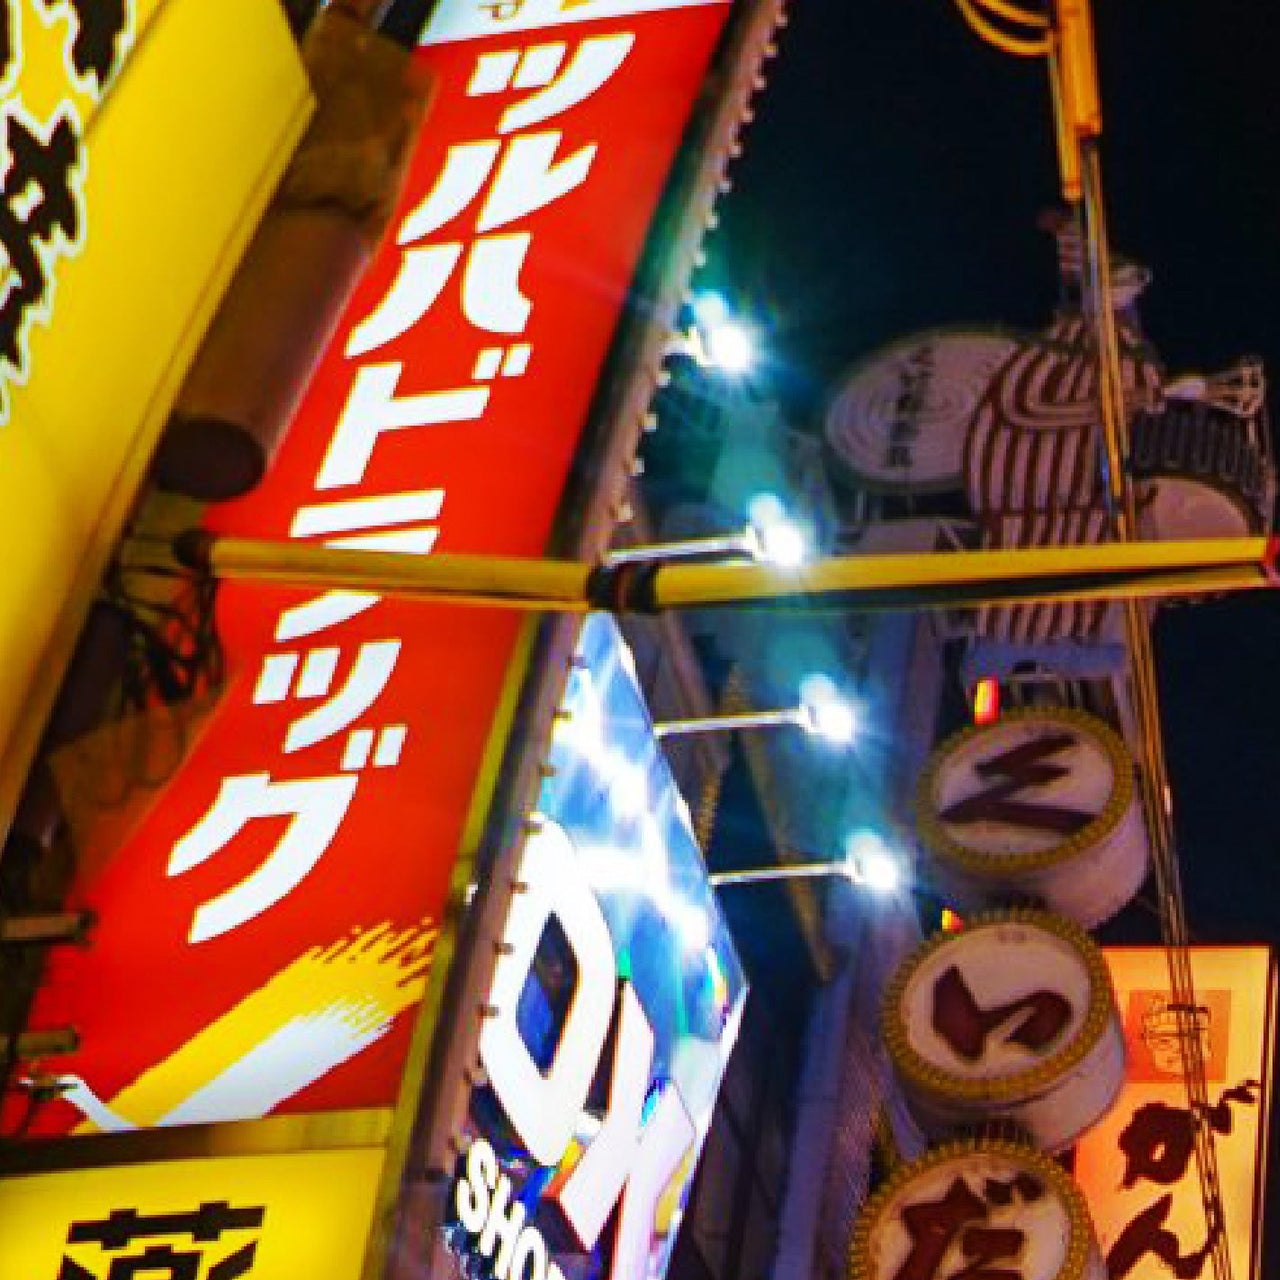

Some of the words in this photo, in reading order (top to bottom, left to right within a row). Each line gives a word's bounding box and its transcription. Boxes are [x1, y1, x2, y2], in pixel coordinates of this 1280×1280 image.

[165, 32, 637, 942] ツルハドラッグ
